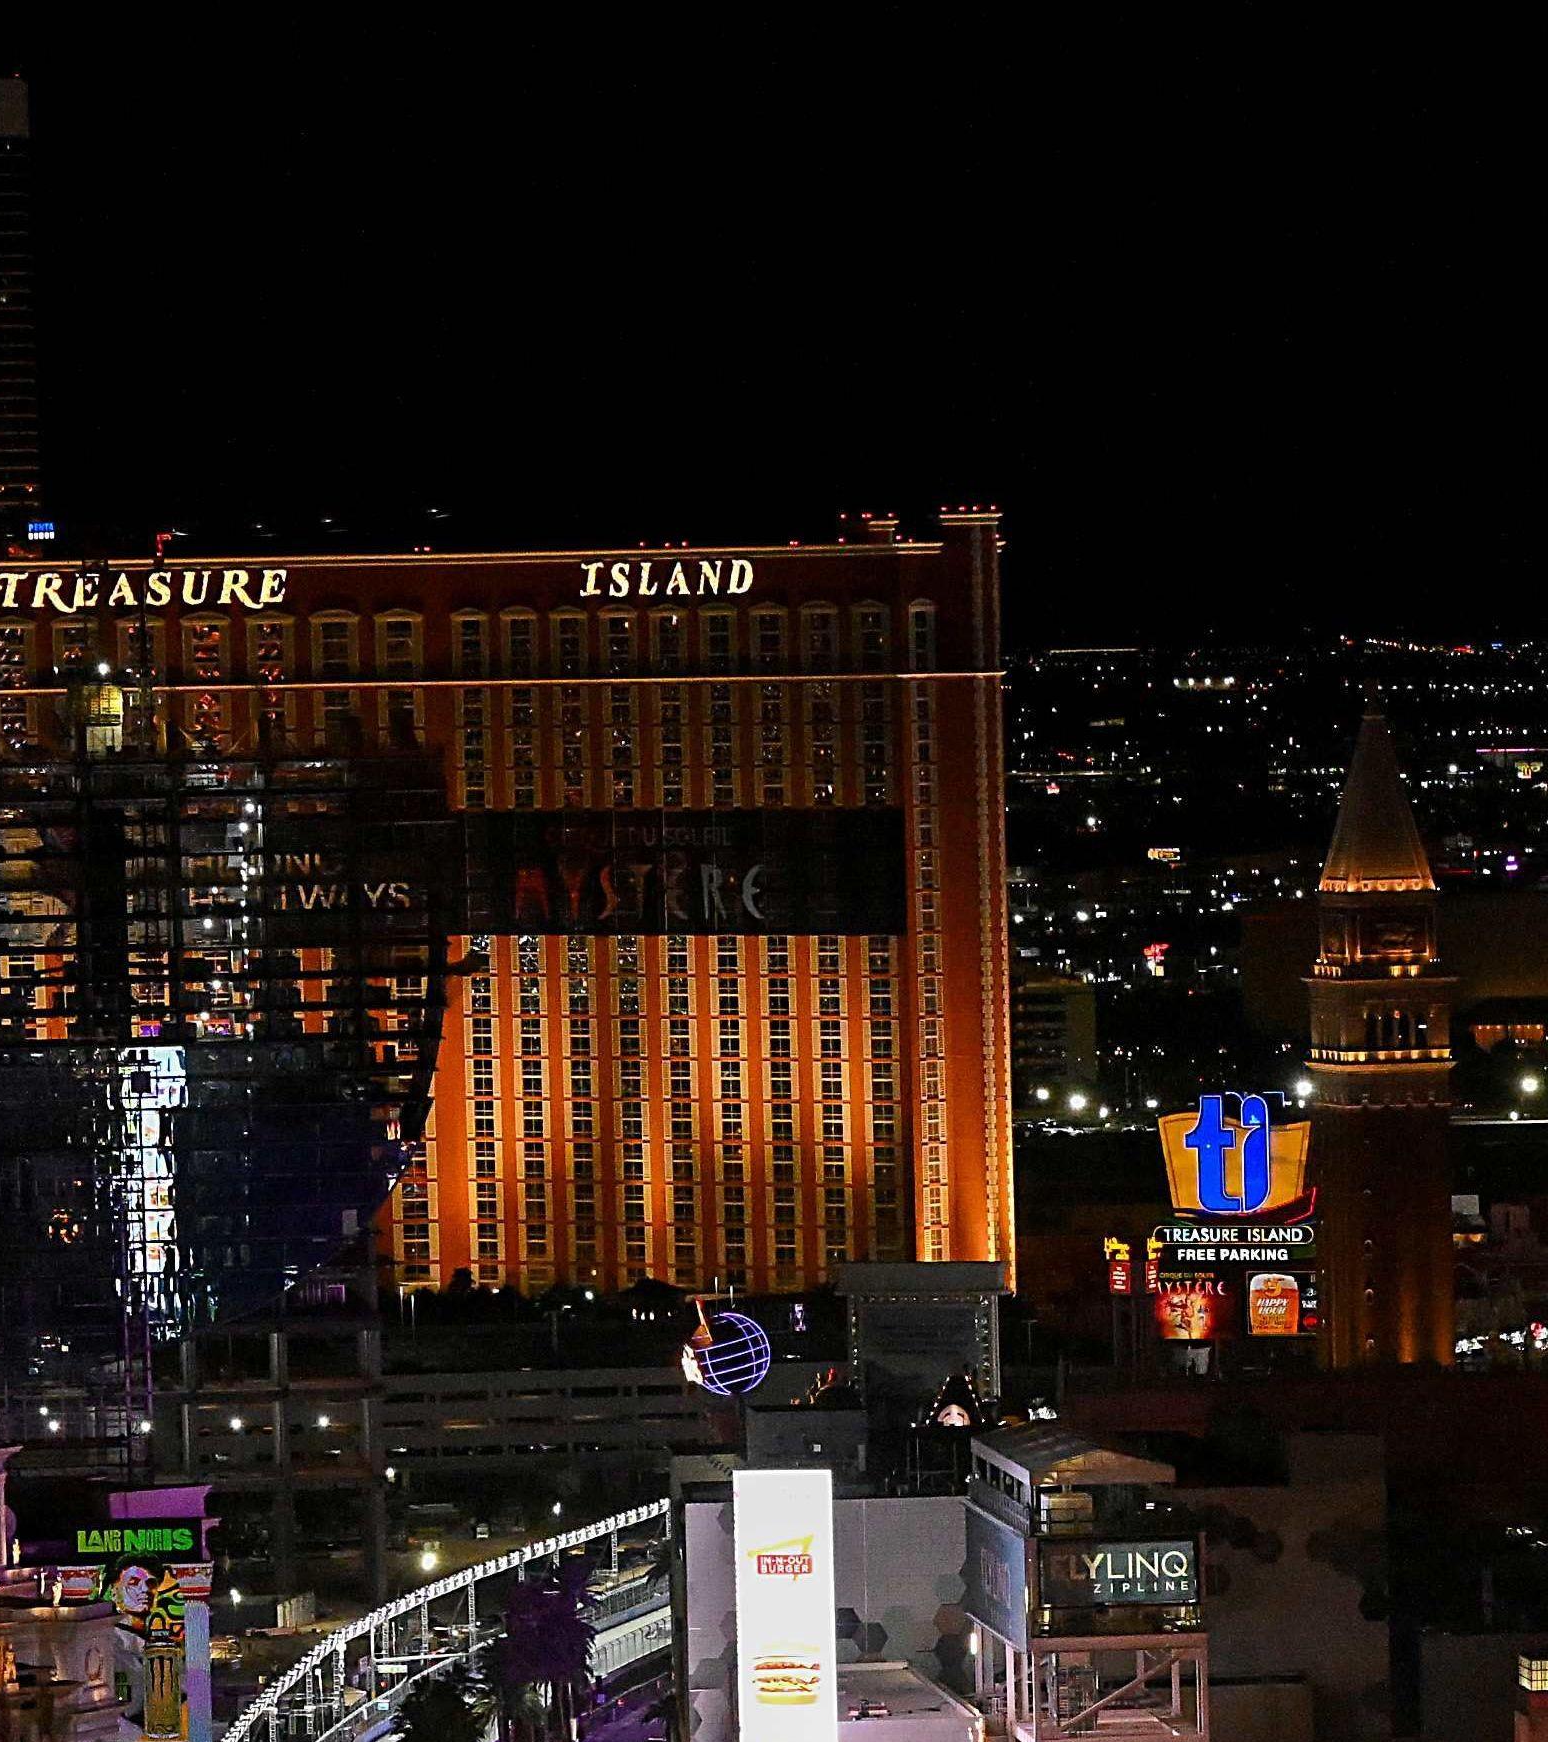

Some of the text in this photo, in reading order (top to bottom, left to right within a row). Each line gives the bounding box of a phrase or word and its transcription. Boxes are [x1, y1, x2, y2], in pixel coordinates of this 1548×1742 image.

[579, 558, 756, 599] ISLAND
[1164, 1227, 1303, 1242] TREASURE ISLAND
[1177, 1249, 1289, 1261] FREE PARKING
[759, 1556, 812, 1566] IN-N-OUT
[760, 1564, 810, 1574] BURGER
[1094, 1582, 1189, 1594] ZIPLINE
